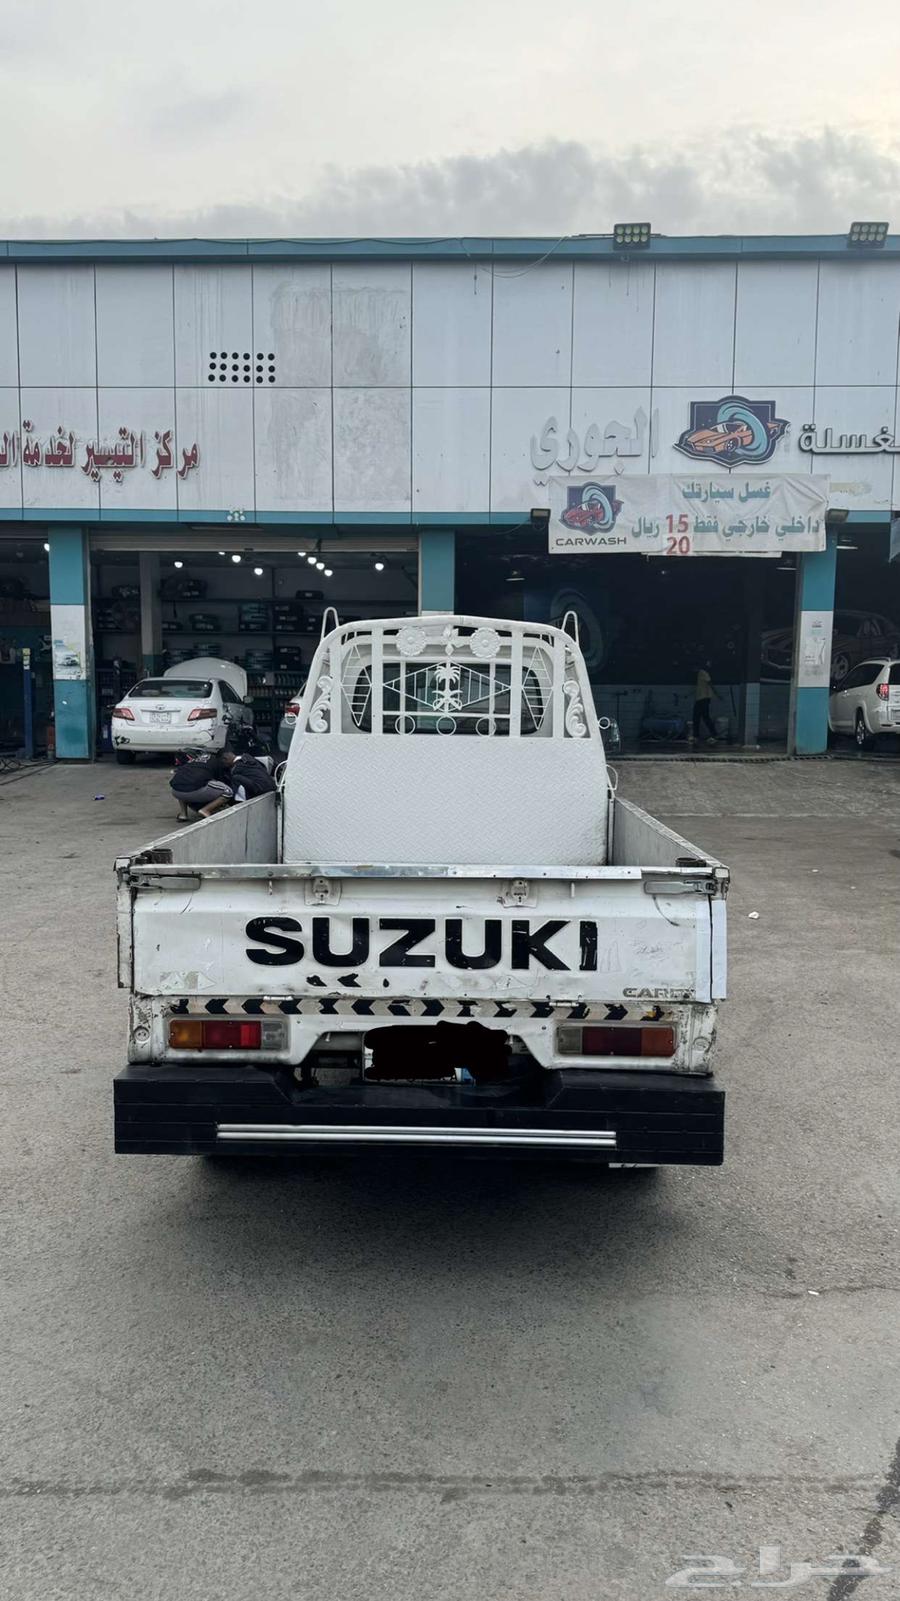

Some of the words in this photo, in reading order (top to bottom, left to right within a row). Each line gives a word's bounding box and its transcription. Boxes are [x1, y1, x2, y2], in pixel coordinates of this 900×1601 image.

[23, 419, 76, 467] لخدمة
[798, 423, 900, 455] غسلة
[81, 426, 145, 482] التيسير
[152, 430, 200, 480] مركز
[682, 481, 735, 504] سيارتك
[738, 481, 771, 503] غسل
[631, 516, 660, 538] ريال
[665, 513, 689, 534] 15
[693, 515, 719, 534] فقط
[722, 515, 770, 542] خارجي
[774, 515, 820, 541] داخلي
[555, 537, 627, 546] CARWASH
[666, 536, 690, 556] 20
[245, 916, 598, 971] SUZUKI
